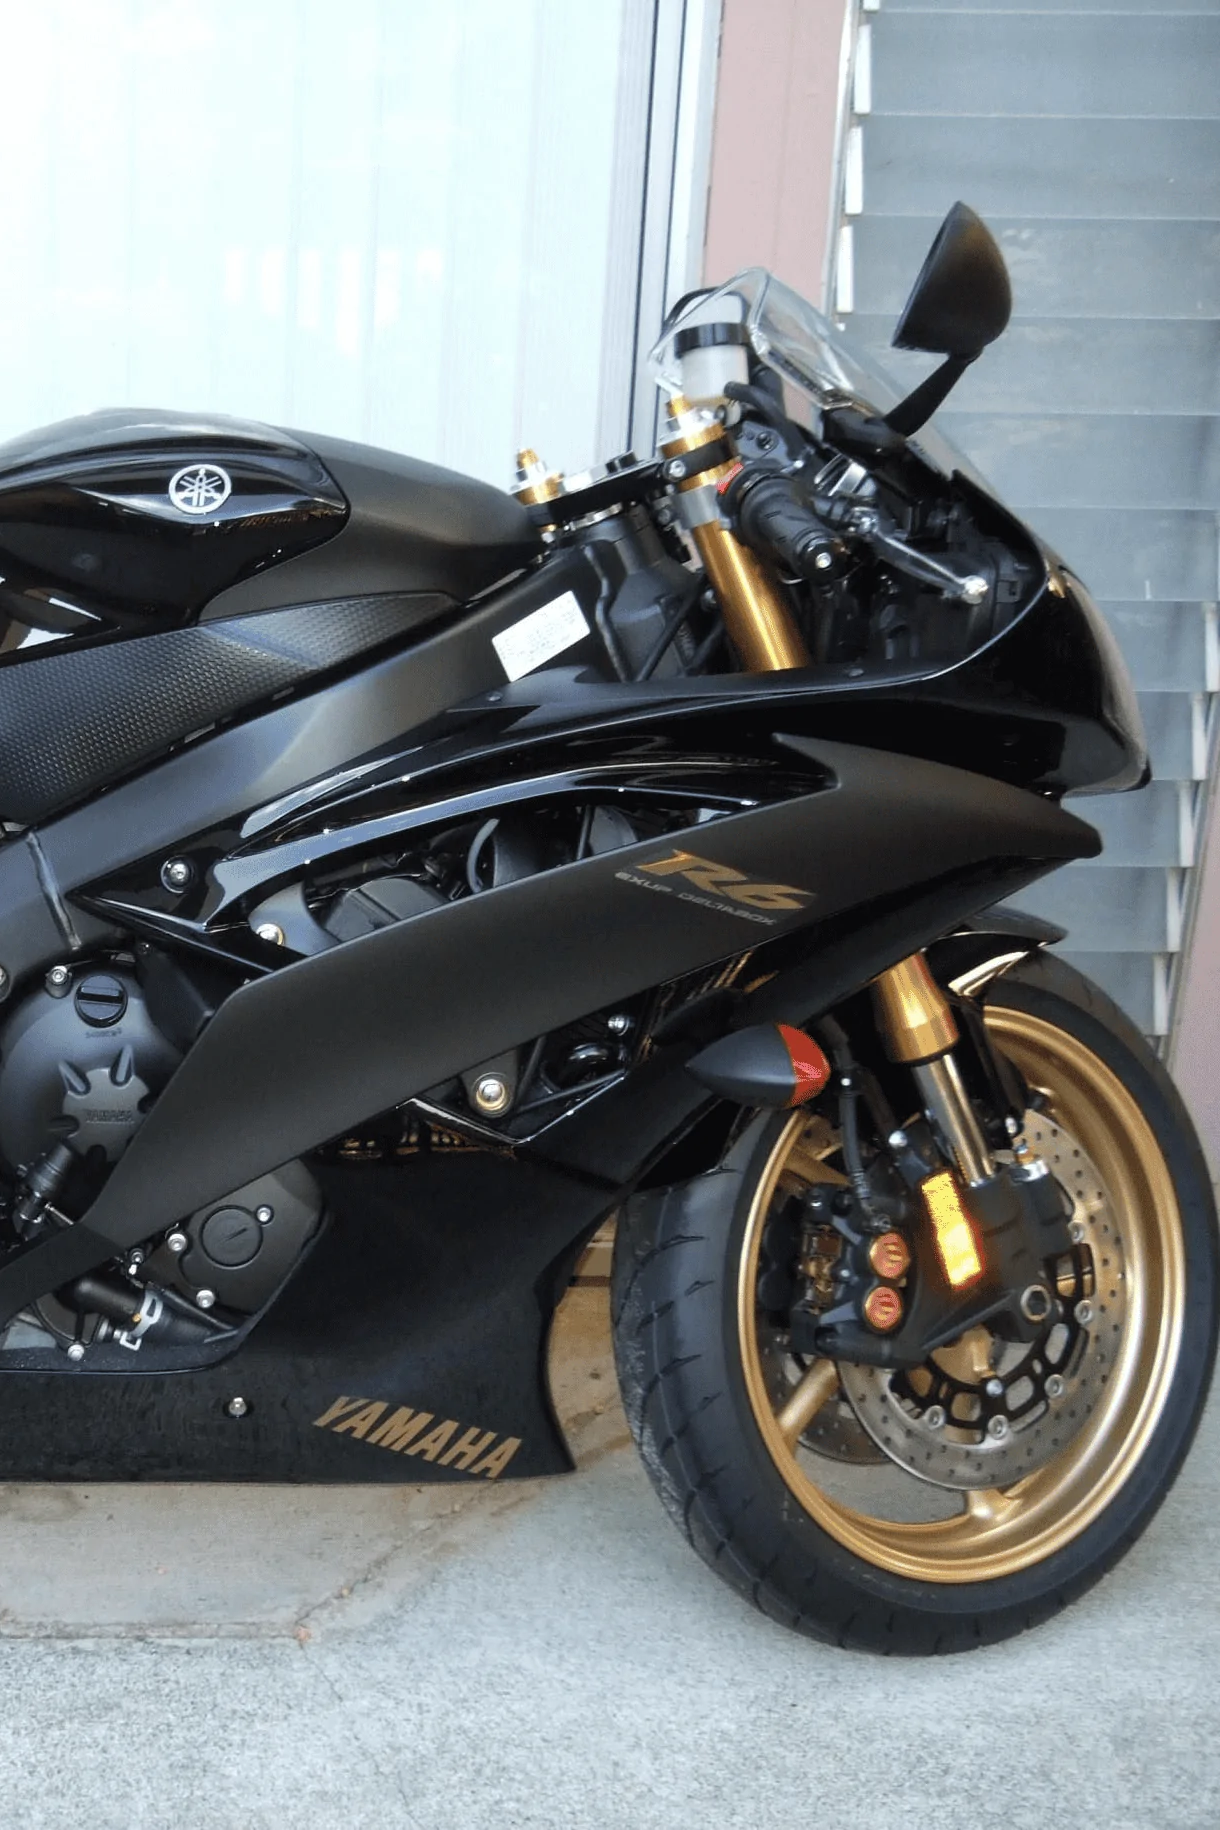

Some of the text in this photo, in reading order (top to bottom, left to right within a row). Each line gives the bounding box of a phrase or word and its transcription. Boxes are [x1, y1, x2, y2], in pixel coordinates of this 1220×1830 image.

[614, 871, 673, 893] EXUP
[636, 849, 817, 910] R6
[312, 1396, 523, 1479] YAMAHA
